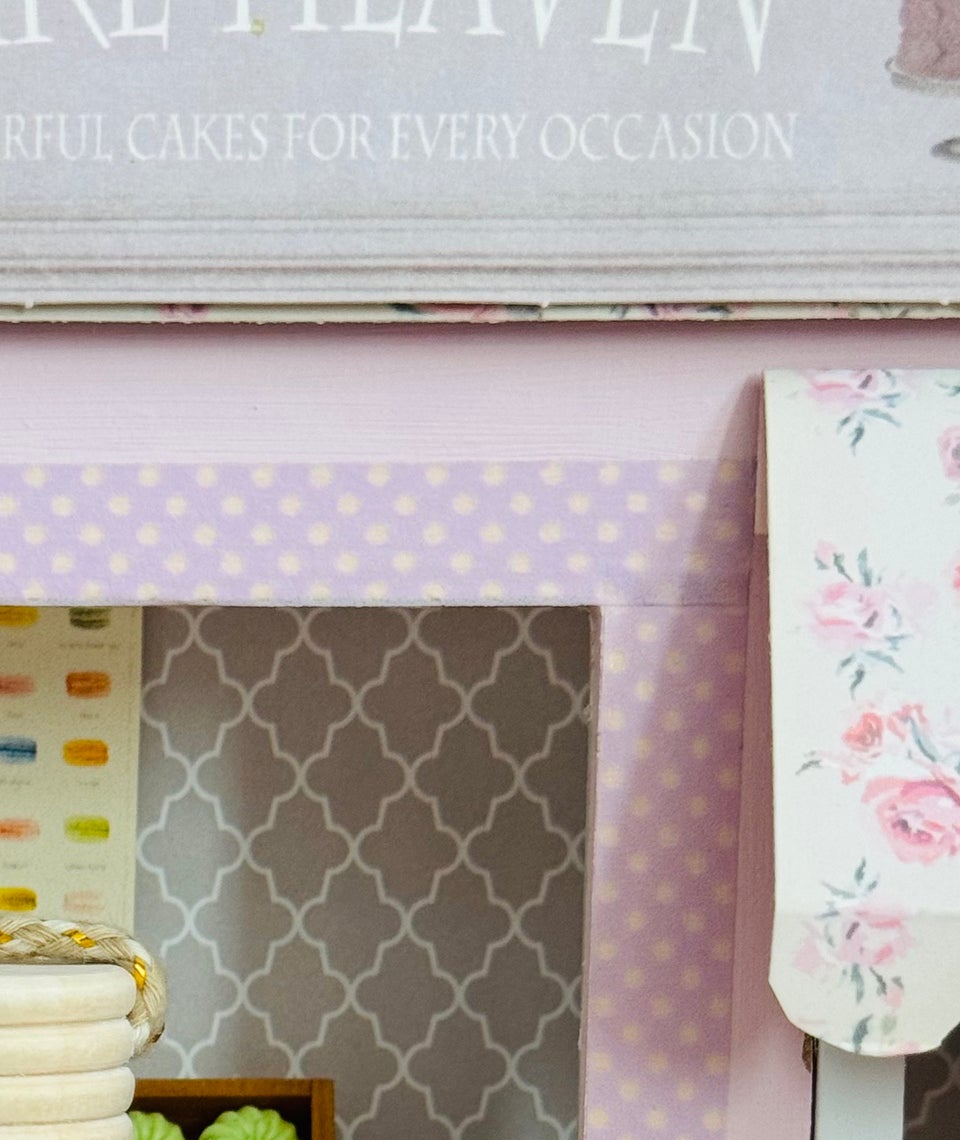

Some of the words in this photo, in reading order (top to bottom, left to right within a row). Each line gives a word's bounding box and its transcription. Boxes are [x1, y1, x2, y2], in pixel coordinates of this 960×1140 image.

[126, 112, 269, 162] CAKES
[283, 112, 380, 162] FOR
[390, 112, 528, 162] EVERY
[540, 112, 798, 162] OCCASION
